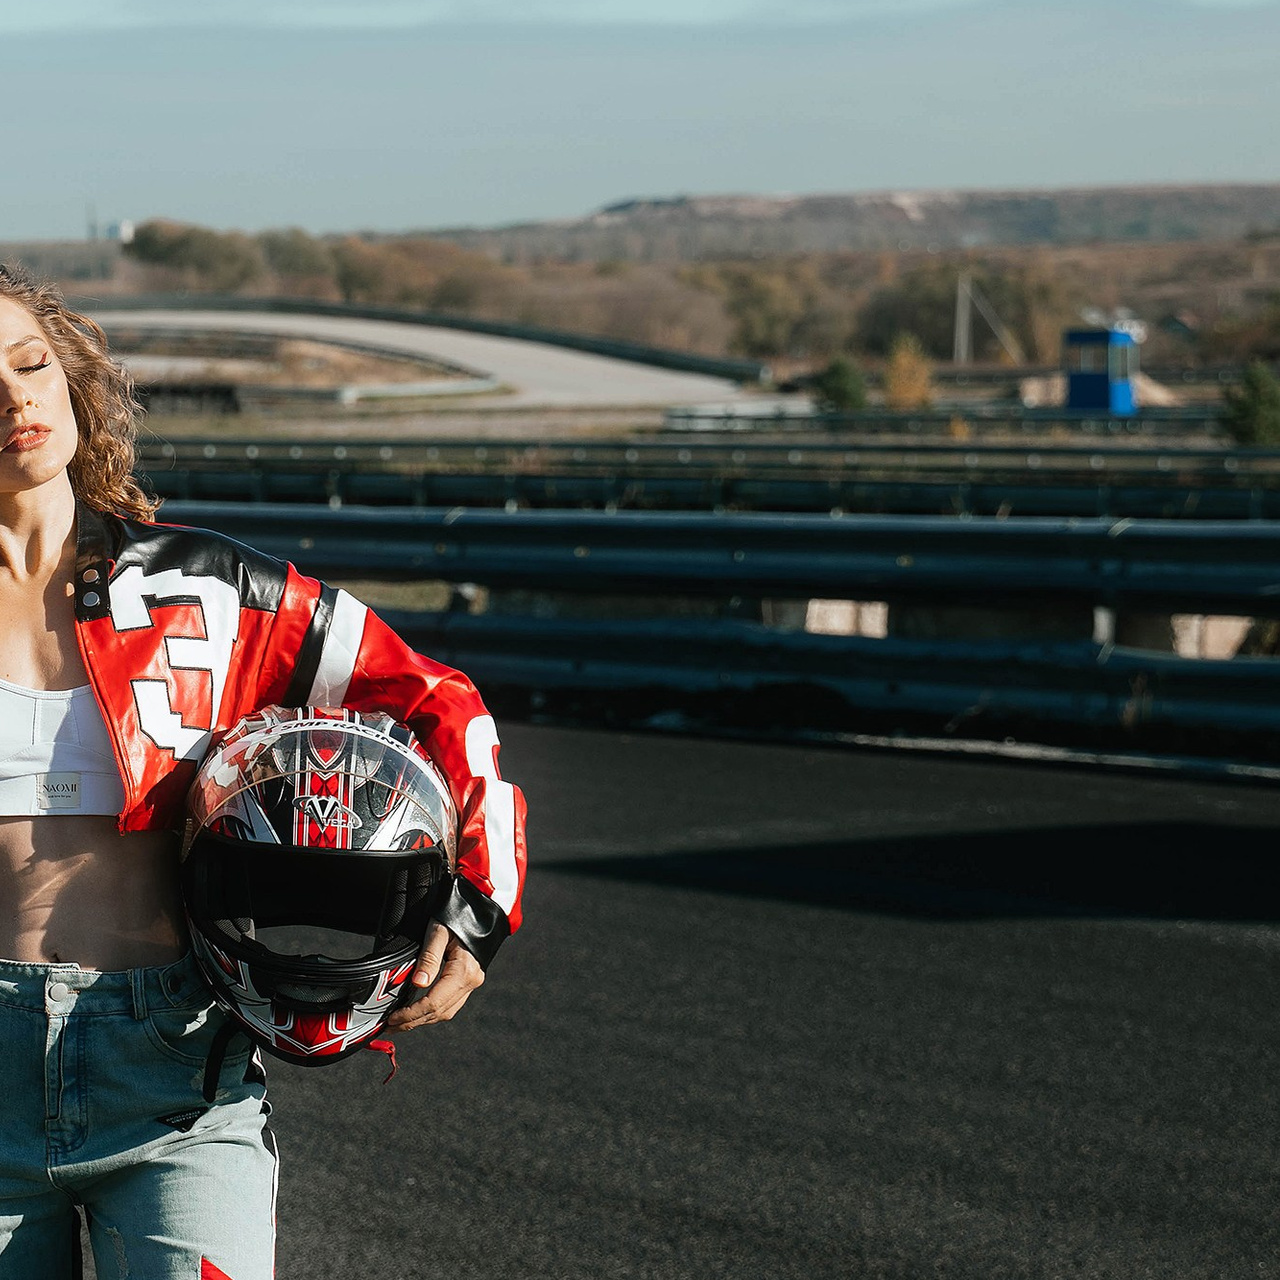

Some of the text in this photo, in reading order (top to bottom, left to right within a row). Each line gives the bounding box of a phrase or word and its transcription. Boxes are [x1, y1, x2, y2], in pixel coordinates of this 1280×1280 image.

[281, 720, 409, 755] SMP RACING
[42, 783, 77, 793] NAOMI
[324, 818, 356, 830] VEGA
